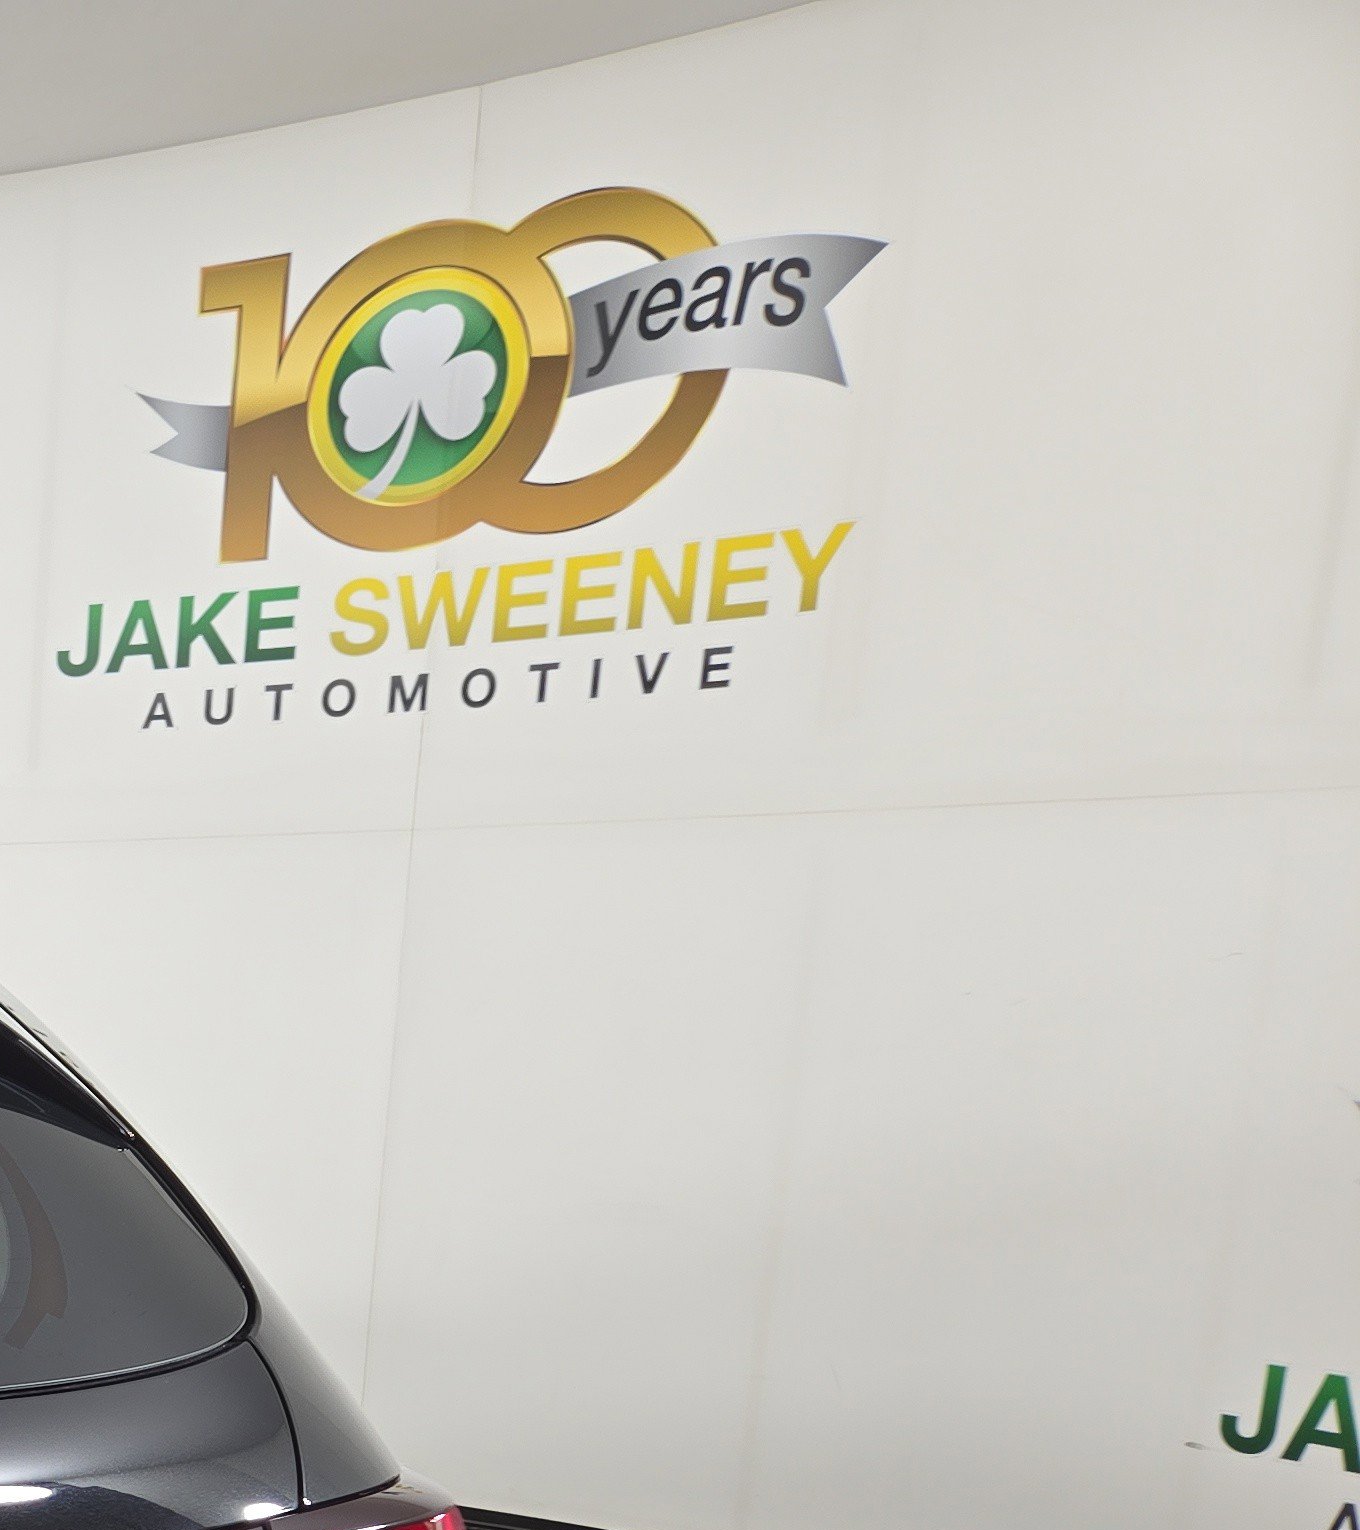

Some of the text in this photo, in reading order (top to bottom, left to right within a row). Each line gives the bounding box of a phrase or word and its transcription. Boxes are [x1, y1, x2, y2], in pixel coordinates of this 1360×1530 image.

[587, 256, 811, 379] years
[57, 520, 855, 678] JAKE SWEENEY
[142, 645, 734, 730] AUTOMOTIVE
[1220, 1364, 1360, 1474] JA
